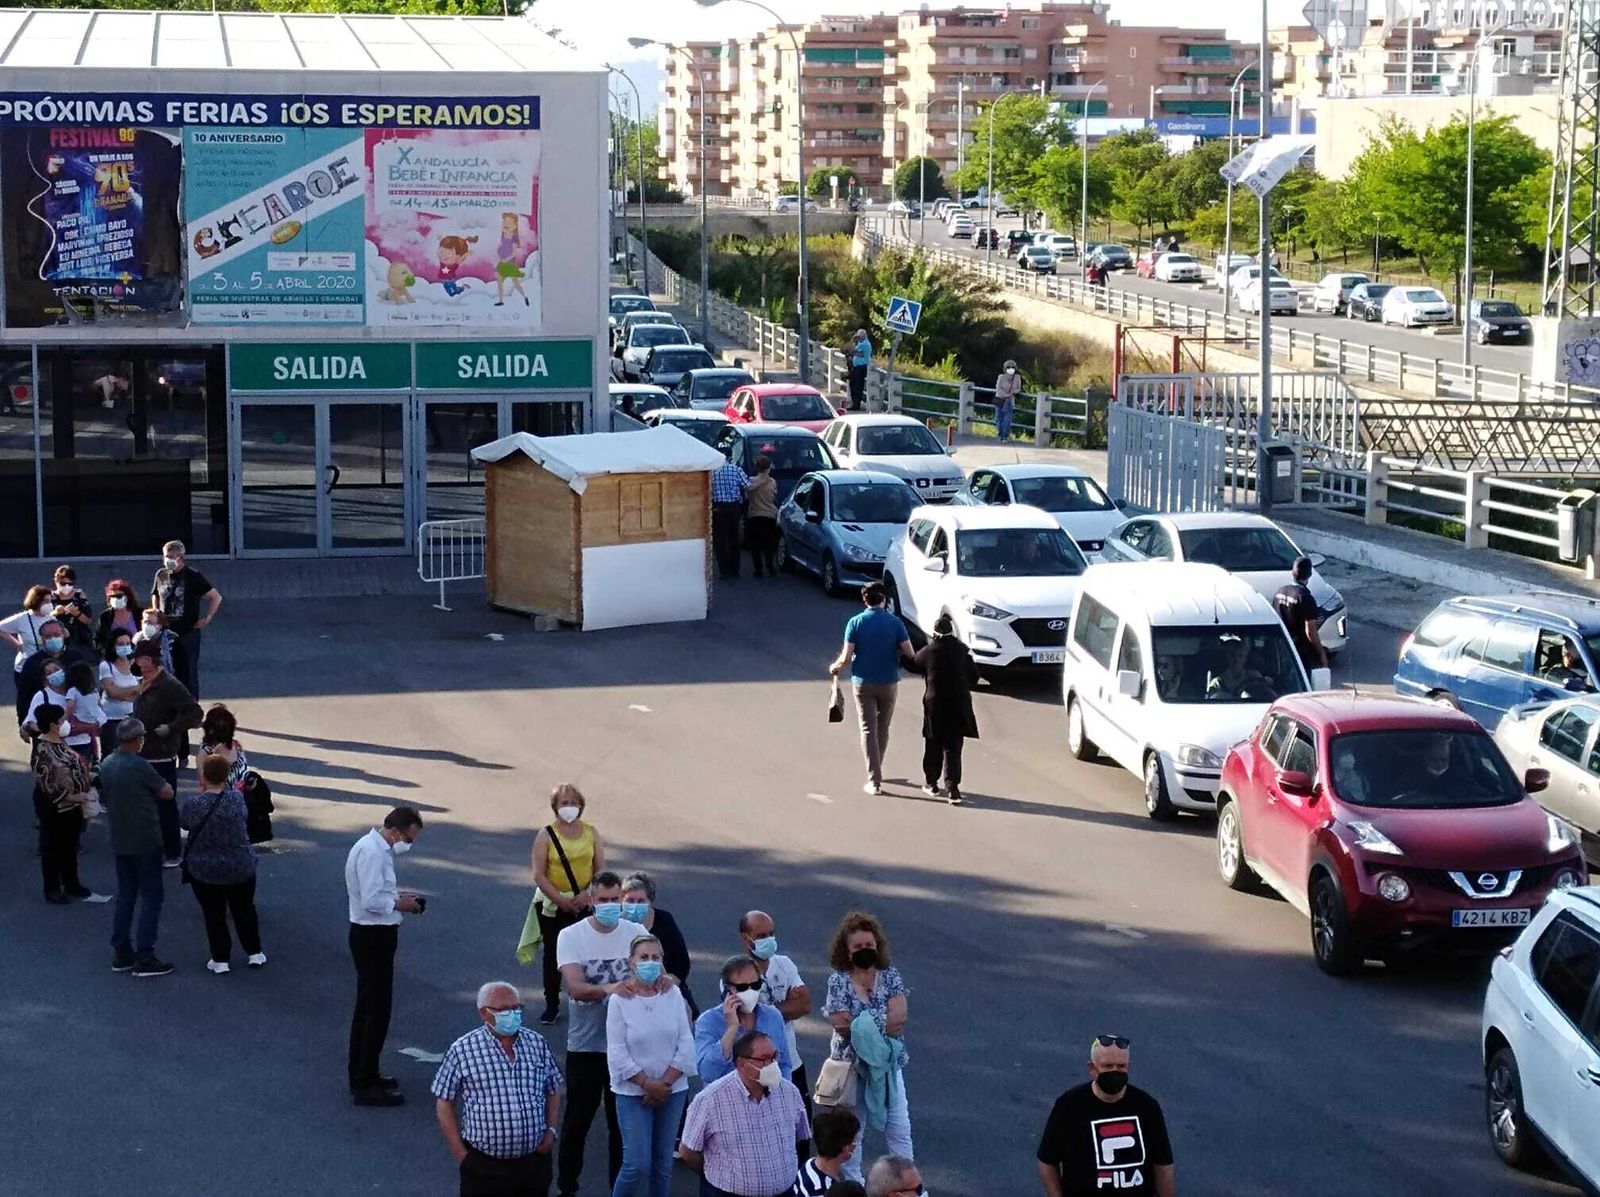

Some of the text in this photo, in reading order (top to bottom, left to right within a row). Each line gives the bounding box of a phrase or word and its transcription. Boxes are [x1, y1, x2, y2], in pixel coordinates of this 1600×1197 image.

[0, 96, 154, 122] PRÓXIMAS
[166, 102, 268, 123] FERIAS
[342, 104, 530, 126] ESPERAMOS!
[1167, 122, 1206, 131] Gasolinera
[50, 128, 120, 148] FESTIVAL
[195, 133, 284, 143] 10 ANIVERSARIO
[397, 146, 490, 167] X ANDALUCÍA
[388, 165, 427, 182] BEBÉ
[439, 168, 518, 183] INFANCIA
[404, 198, 423, 208] 14
[432, 198, 449, 209] 15
[459, 199, 498, 208] MARZO
[56, 218, 77, 229] PACO
[108, 219, 127, 231] BAYO
[213, 272, 228, 291] 3
[232, 281, 244, 290] AL
[250, 272, 262, 291] 5
[276, 276, 313, 290] ABRIL
[317, 275, 357, 290] 2020
[273, 356, 367, 380] SALIDA
[458, 354, 548, 378] SALIDA
[1039, 652, 1061, 662] 8364
[1462, 911, 1528, 925] 4214 KBZ
[1097, 1169, 1144, 1189] FILA
